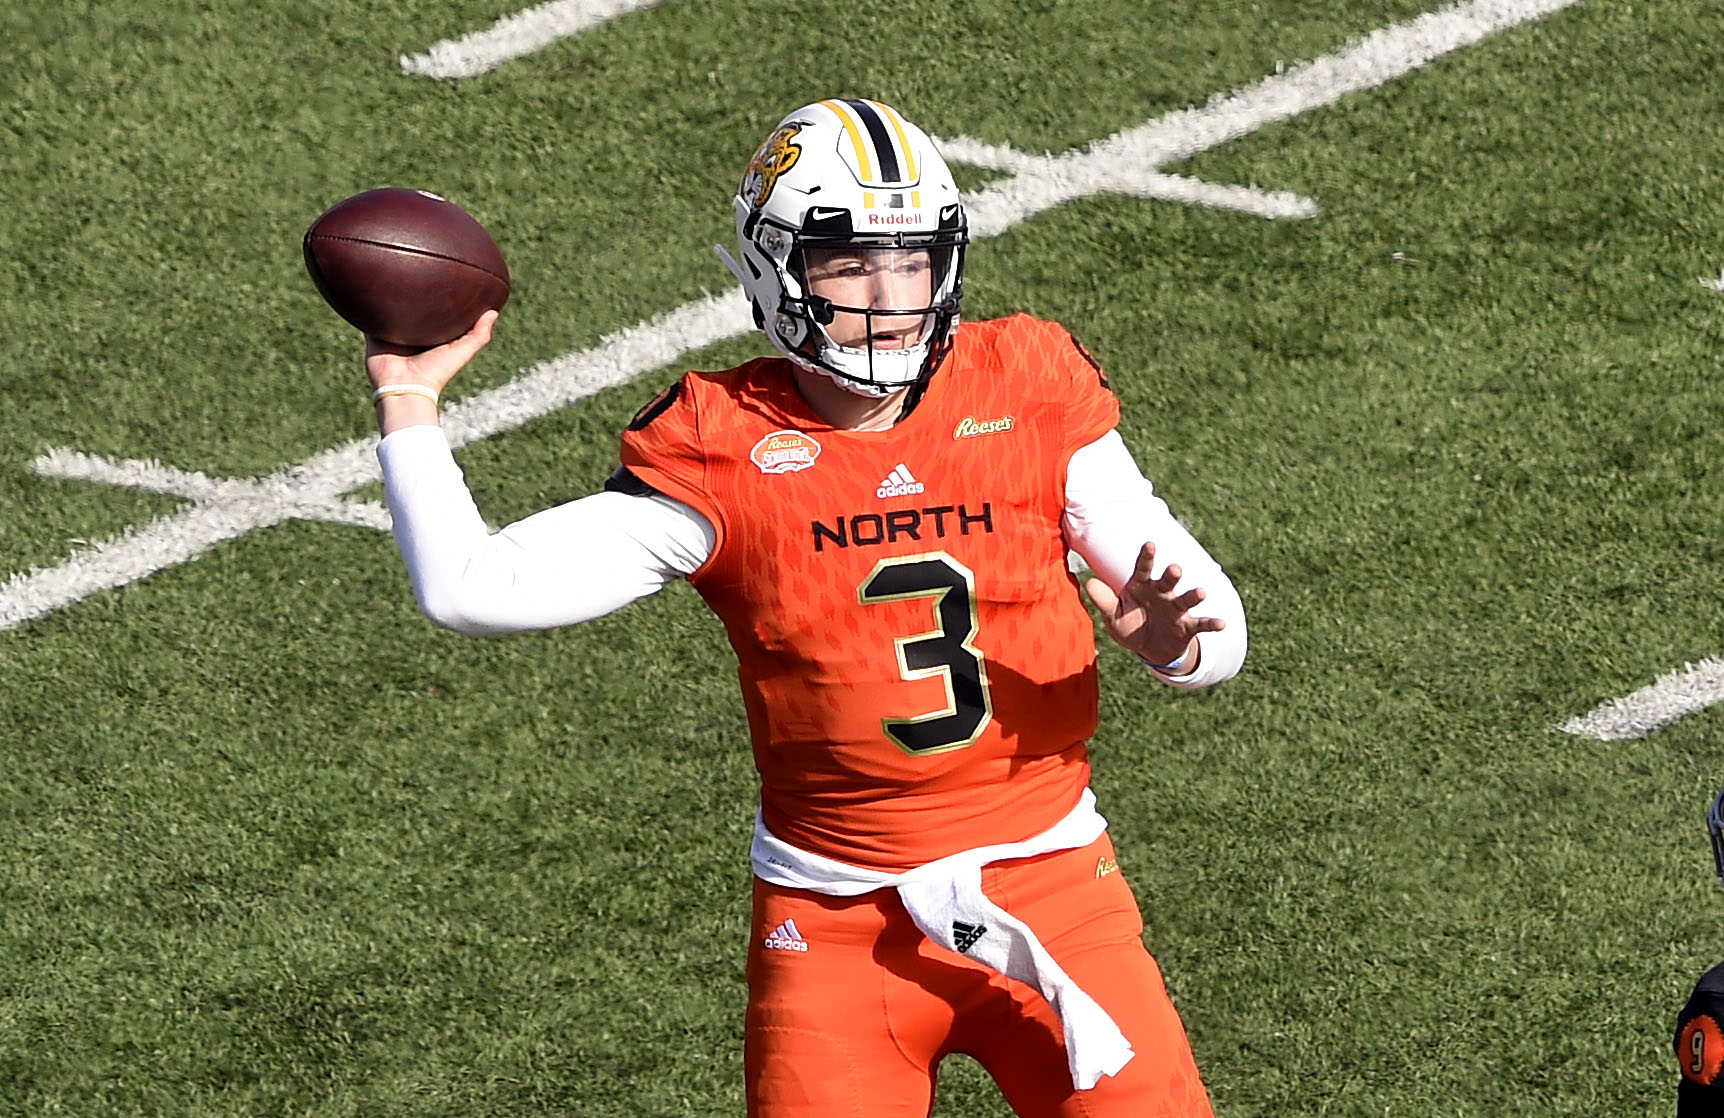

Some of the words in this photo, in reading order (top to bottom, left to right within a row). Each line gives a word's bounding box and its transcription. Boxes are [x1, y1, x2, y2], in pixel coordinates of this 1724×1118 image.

[869, 213, 923, 225] Riddell
[954, 416, 1013, 440] Reese's
[876, 482, 925, 498] adidas
[812, 503, 993, 551] NORTH
[857, 551, 993, 756] 3
[764, 938, 809, 952] adidas
[957, 925, 988, 953] adidas
[1691, 1029, 1705, 1074] 9
